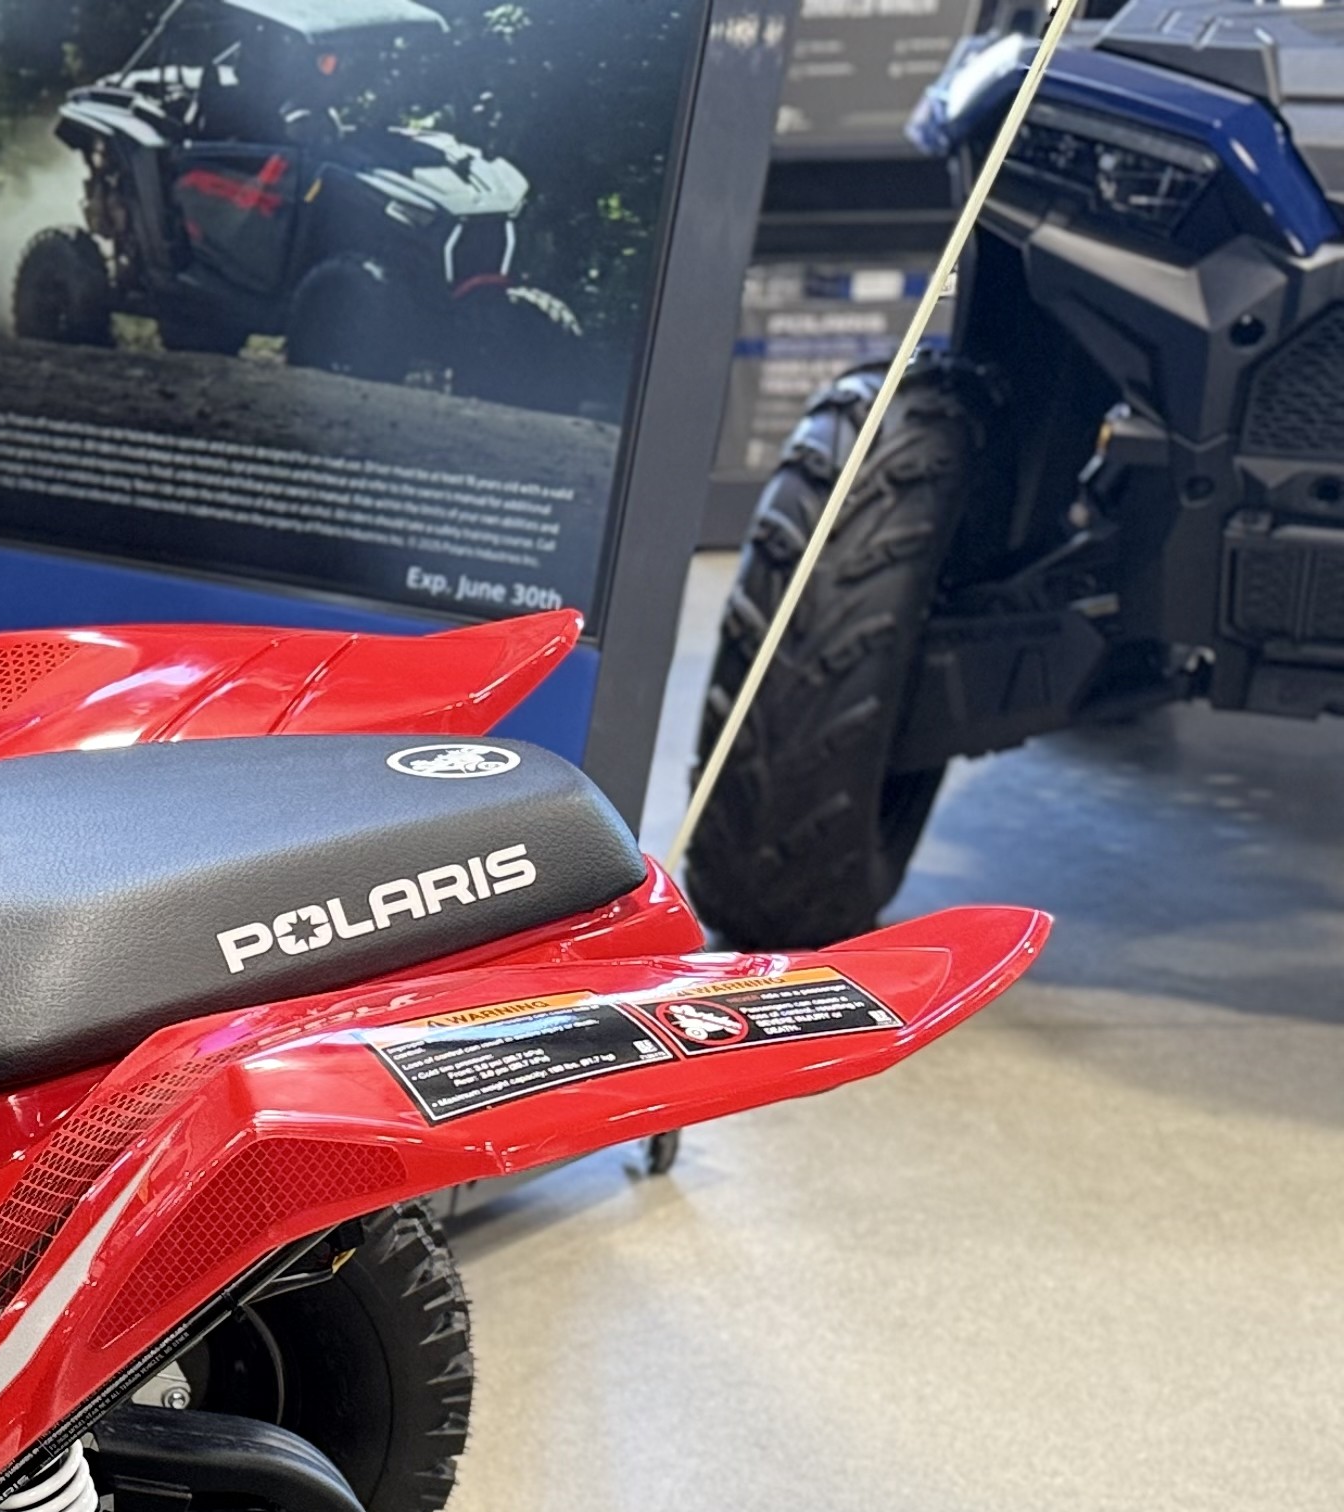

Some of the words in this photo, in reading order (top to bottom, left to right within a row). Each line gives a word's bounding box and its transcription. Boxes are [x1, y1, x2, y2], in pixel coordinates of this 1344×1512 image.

[405, 565, 452, 597] Exp.
[454, 573, 507, 603] June
[510, 581, 563, 611] 30th
[216, 841, 537, 975] POLARIS
[691, 975, 786, 997] WARNING
[444, 999, 552, 1027] WARNING
